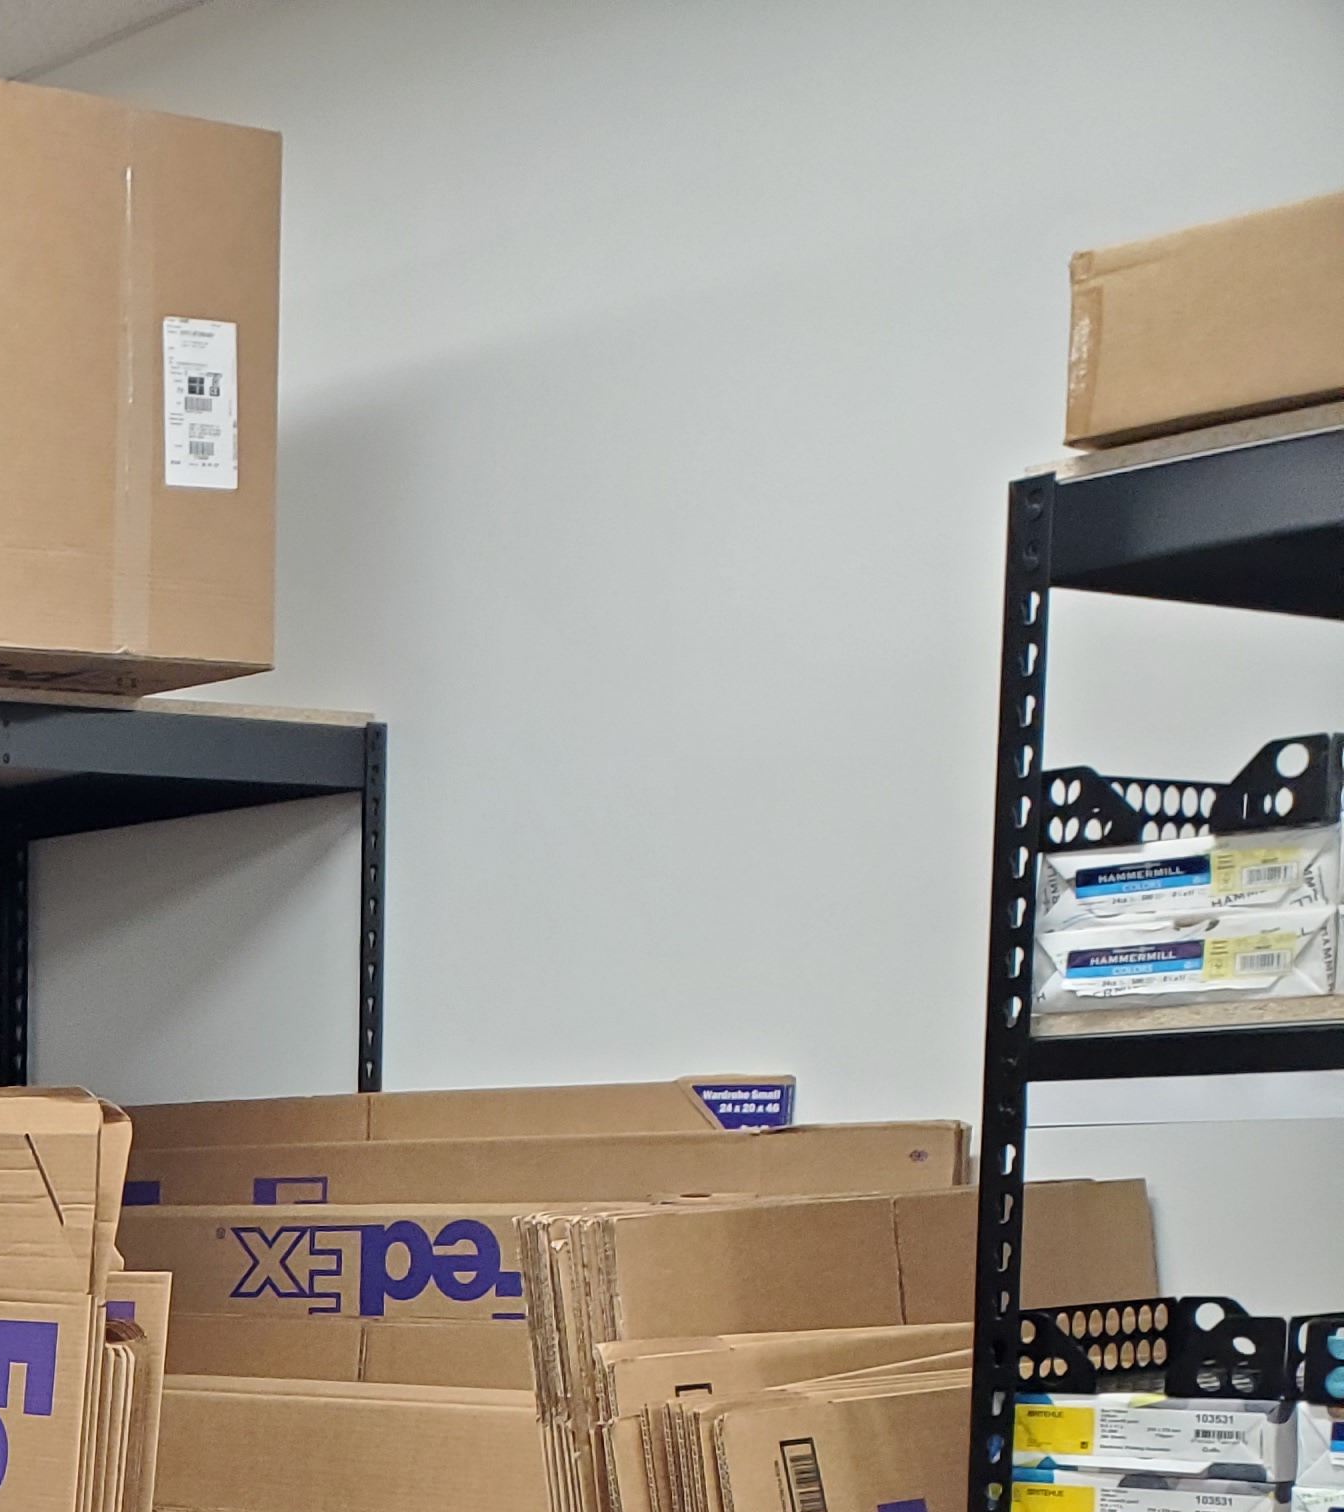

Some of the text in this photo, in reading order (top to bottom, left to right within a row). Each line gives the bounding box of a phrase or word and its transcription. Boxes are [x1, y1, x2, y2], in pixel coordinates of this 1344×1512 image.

[1097, 866, 1185, 884] HAMMERMILL
[1089, 950, 1177, 966] HAMMERMILL
[702, 1089, 782, 1100] Wardrobe Small
[1195, 1413, 1234, 1425] 103531
[1195, 1495, 1233, 1507] 103531
